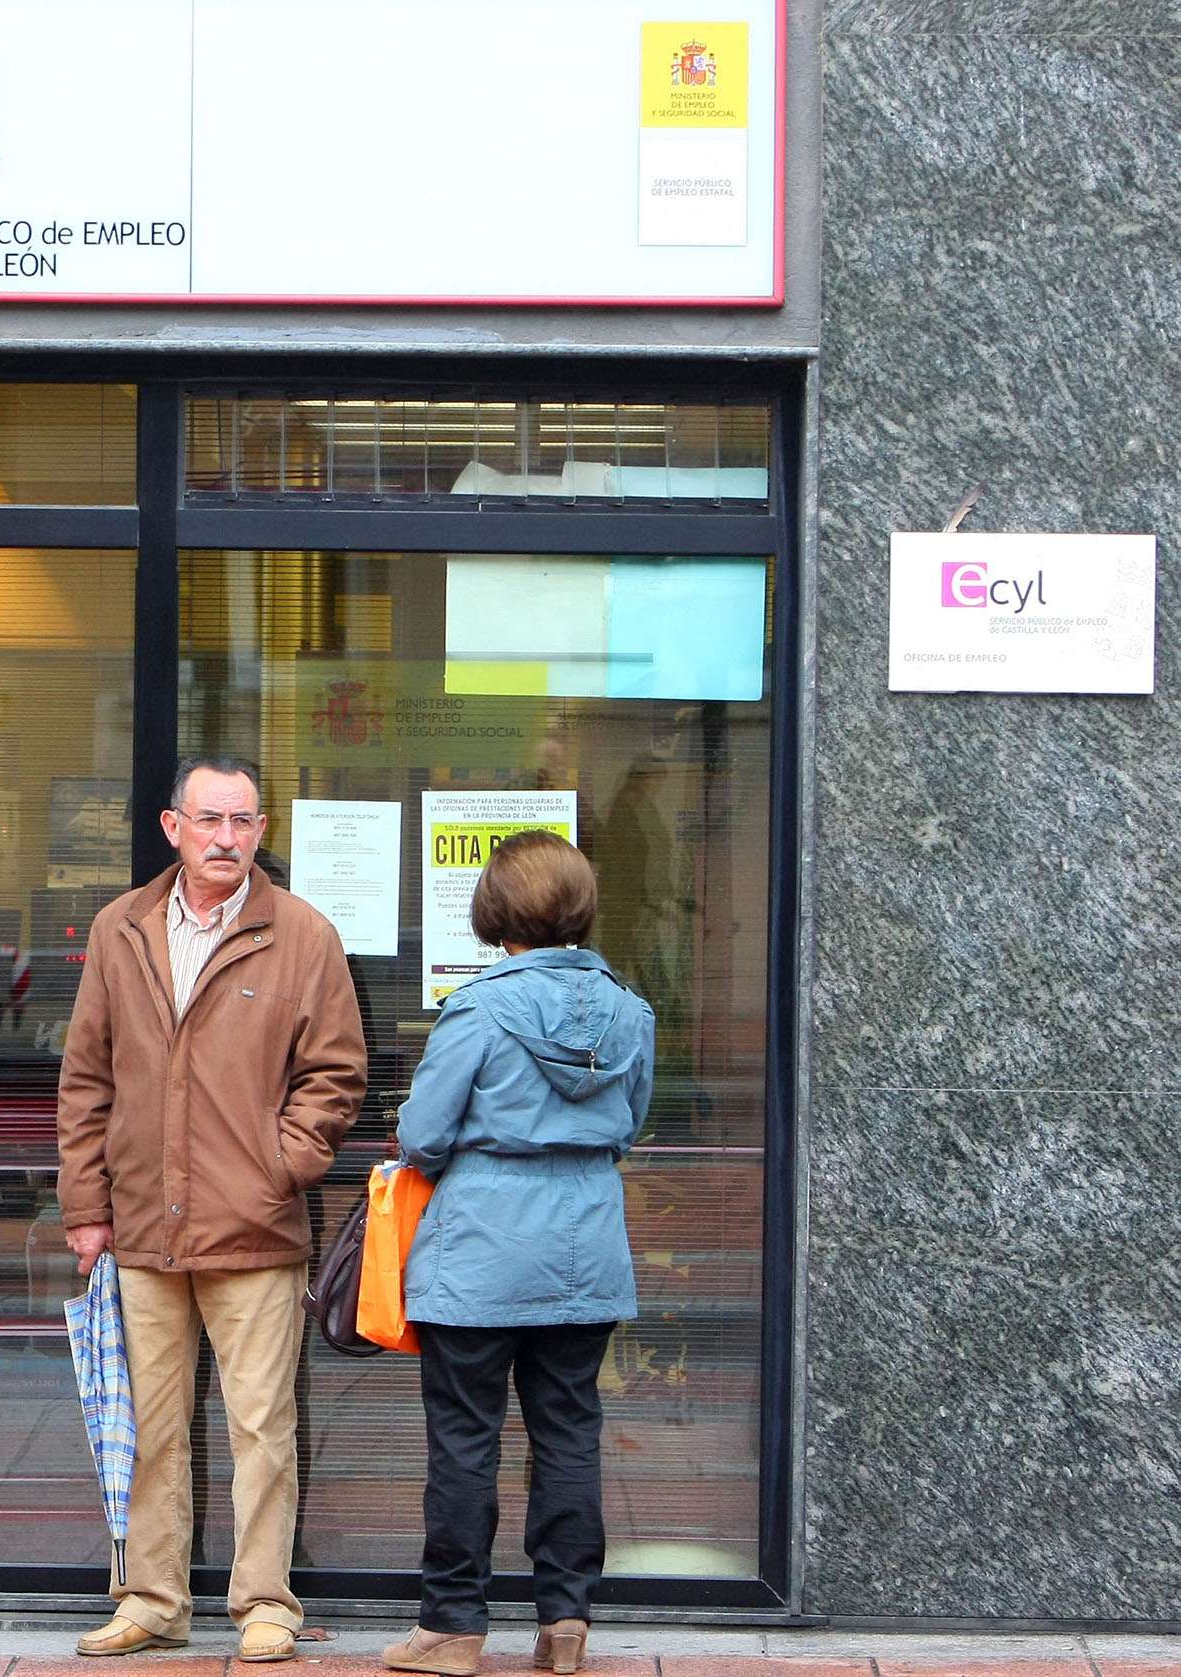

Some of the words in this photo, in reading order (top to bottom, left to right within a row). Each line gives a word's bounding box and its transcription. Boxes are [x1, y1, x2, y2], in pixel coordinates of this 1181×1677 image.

[671, 93, 716, 101] MINISTERIO
[671, 101, 682, 109] DE
[684, 101, 715, 109] EMPLEO
[652, 110, 656, 118] Y
[658, 110, 705, 118] SEGURIDAD
[707, 110, 735, 118] SOCIAL
[654, 179, 692, 188] SERVICIO
[651, 188, 662, 197] DE
[665, 188, 697, 197] EMPLEO
[41, 221, 73, 246] de
[83, 222, 186, 247] EMPLEO
[951, 563, 1046, 614] ecyl
[989, 617, 1026, 626] SERVICIO
[1076, 617, 1108, 627] EMPLEO
[1002, 626, 1038, 634] CASTILLA
[1040, 626, 1047, 634] Y
[903, 653, 945, 663] OFICINA
[949, 653, 962, 663] DE
[965, 654, 1007, 664] EMPLEO
[395, 698, 465, 710] MINISTERIO
[395, 712, 412, 723] DE
[415, 713, 461, 724] EMPLEO
[395, 726, 404, 737] Y
[405, 726, 477, 738] SEGURIDAD
[480, 727, 523, 739] SOCIAL
[435, 835, 481, 865] CITA
[477, 950, 492, 959] 987
